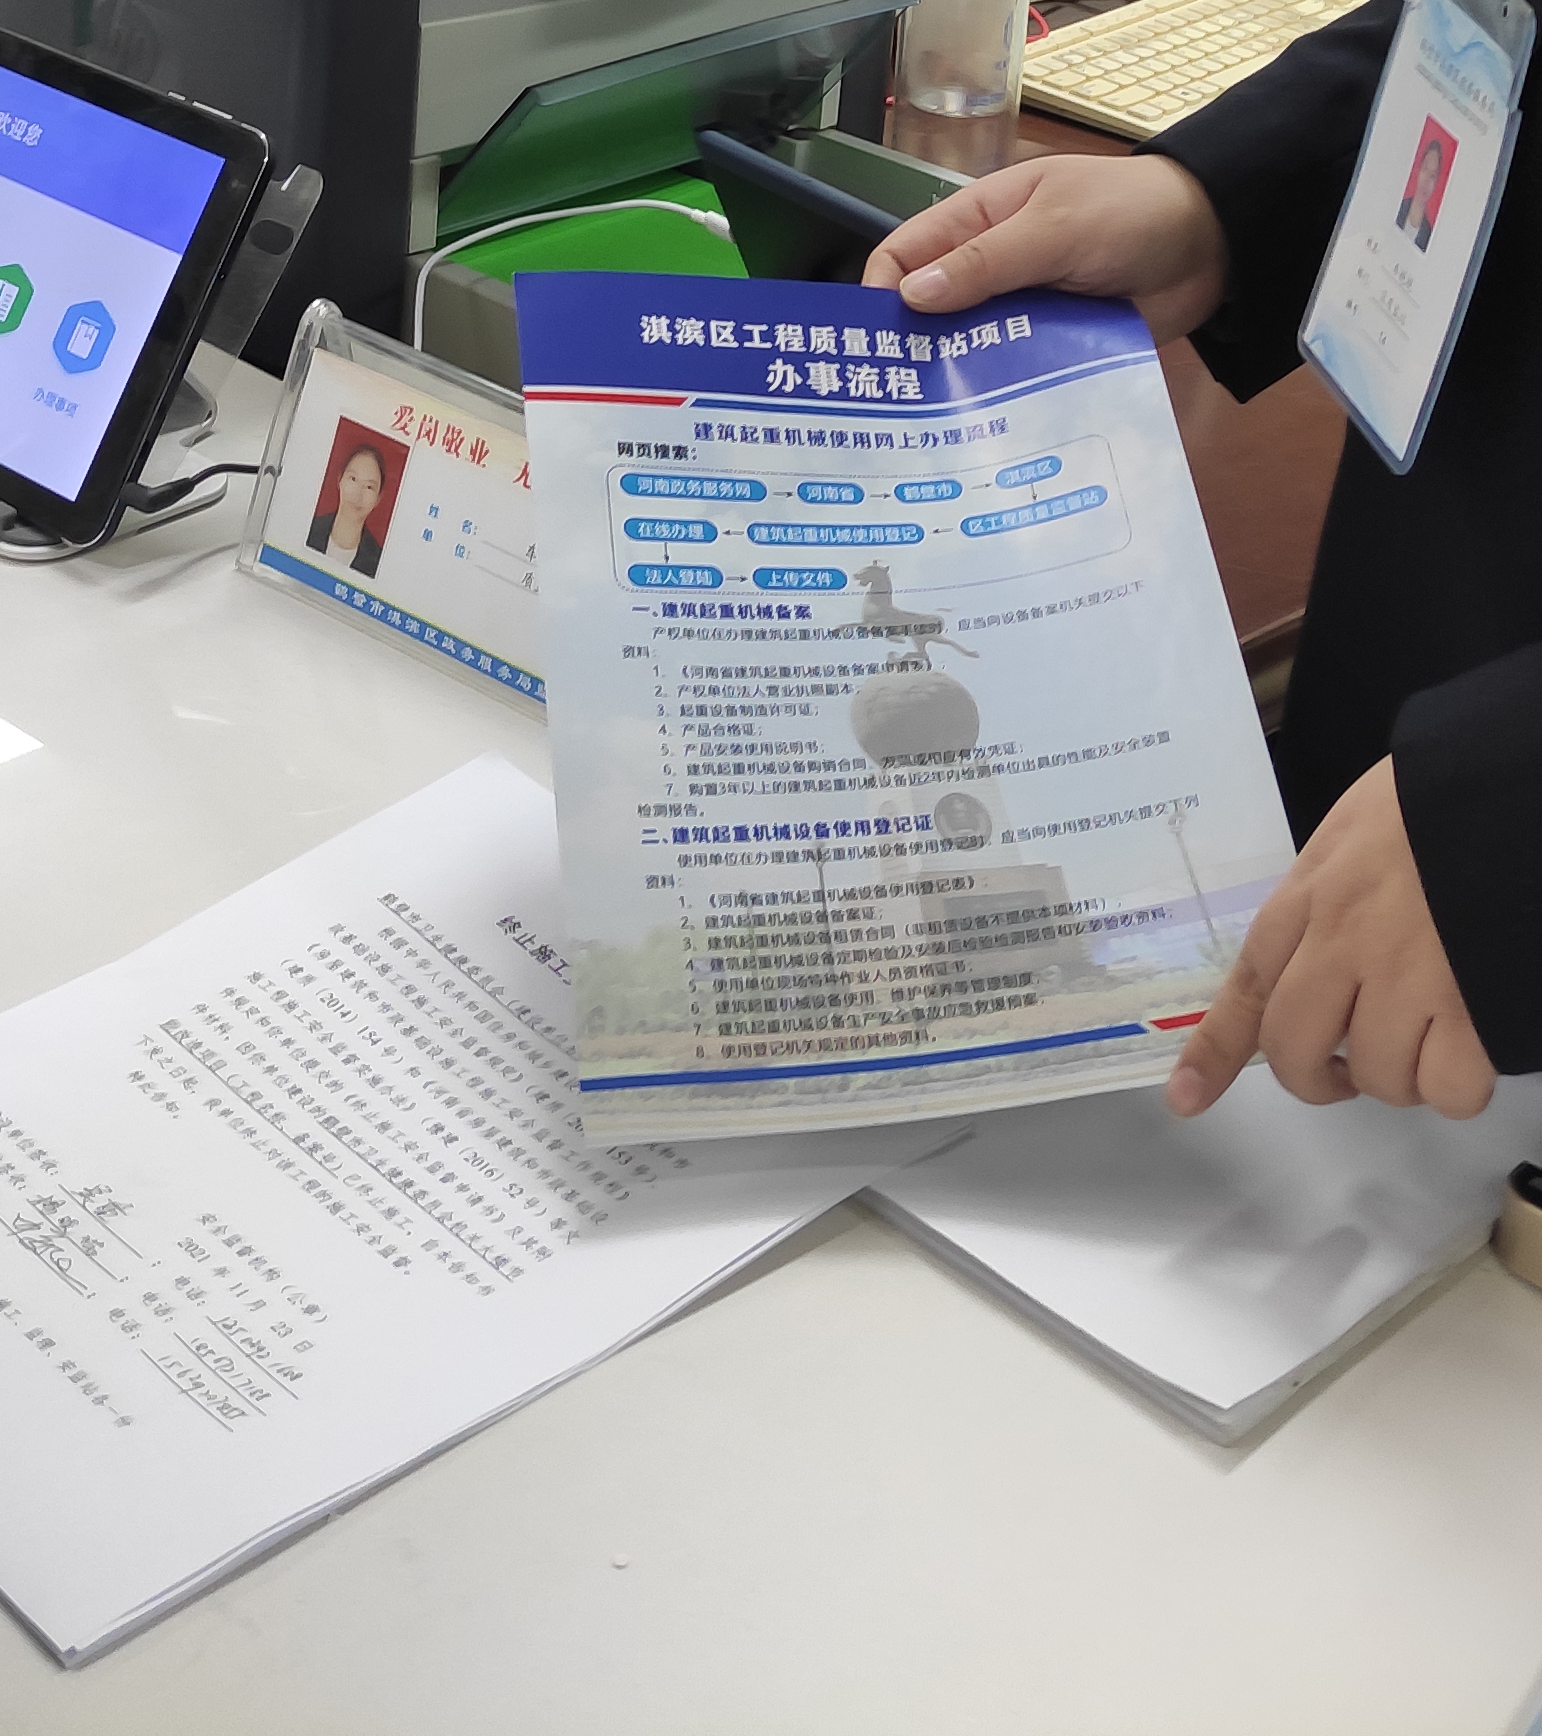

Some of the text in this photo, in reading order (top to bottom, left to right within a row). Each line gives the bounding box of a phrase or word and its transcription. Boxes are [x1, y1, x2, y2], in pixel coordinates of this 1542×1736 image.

[639, 314, 1033, 362] 淇滨区工程质量监督站项目
[765, 356, 925, 401] 办事流程
[392, 403, 492, 469] 爱岗敬业
[693, 416, 1009, 451] 建筑起重机械使用网上办理流程
[637, 476, 752, 499] 河南政务服务网
[806, 485, 856, 502] 河南省
[638, 521, 705, 541] 在线办理
[753, 524, 920, 543] 建筑起重机械使用登记
[767, 570, 835, 588] 上传文件
[495, 914, 573, 986] 终止施工
